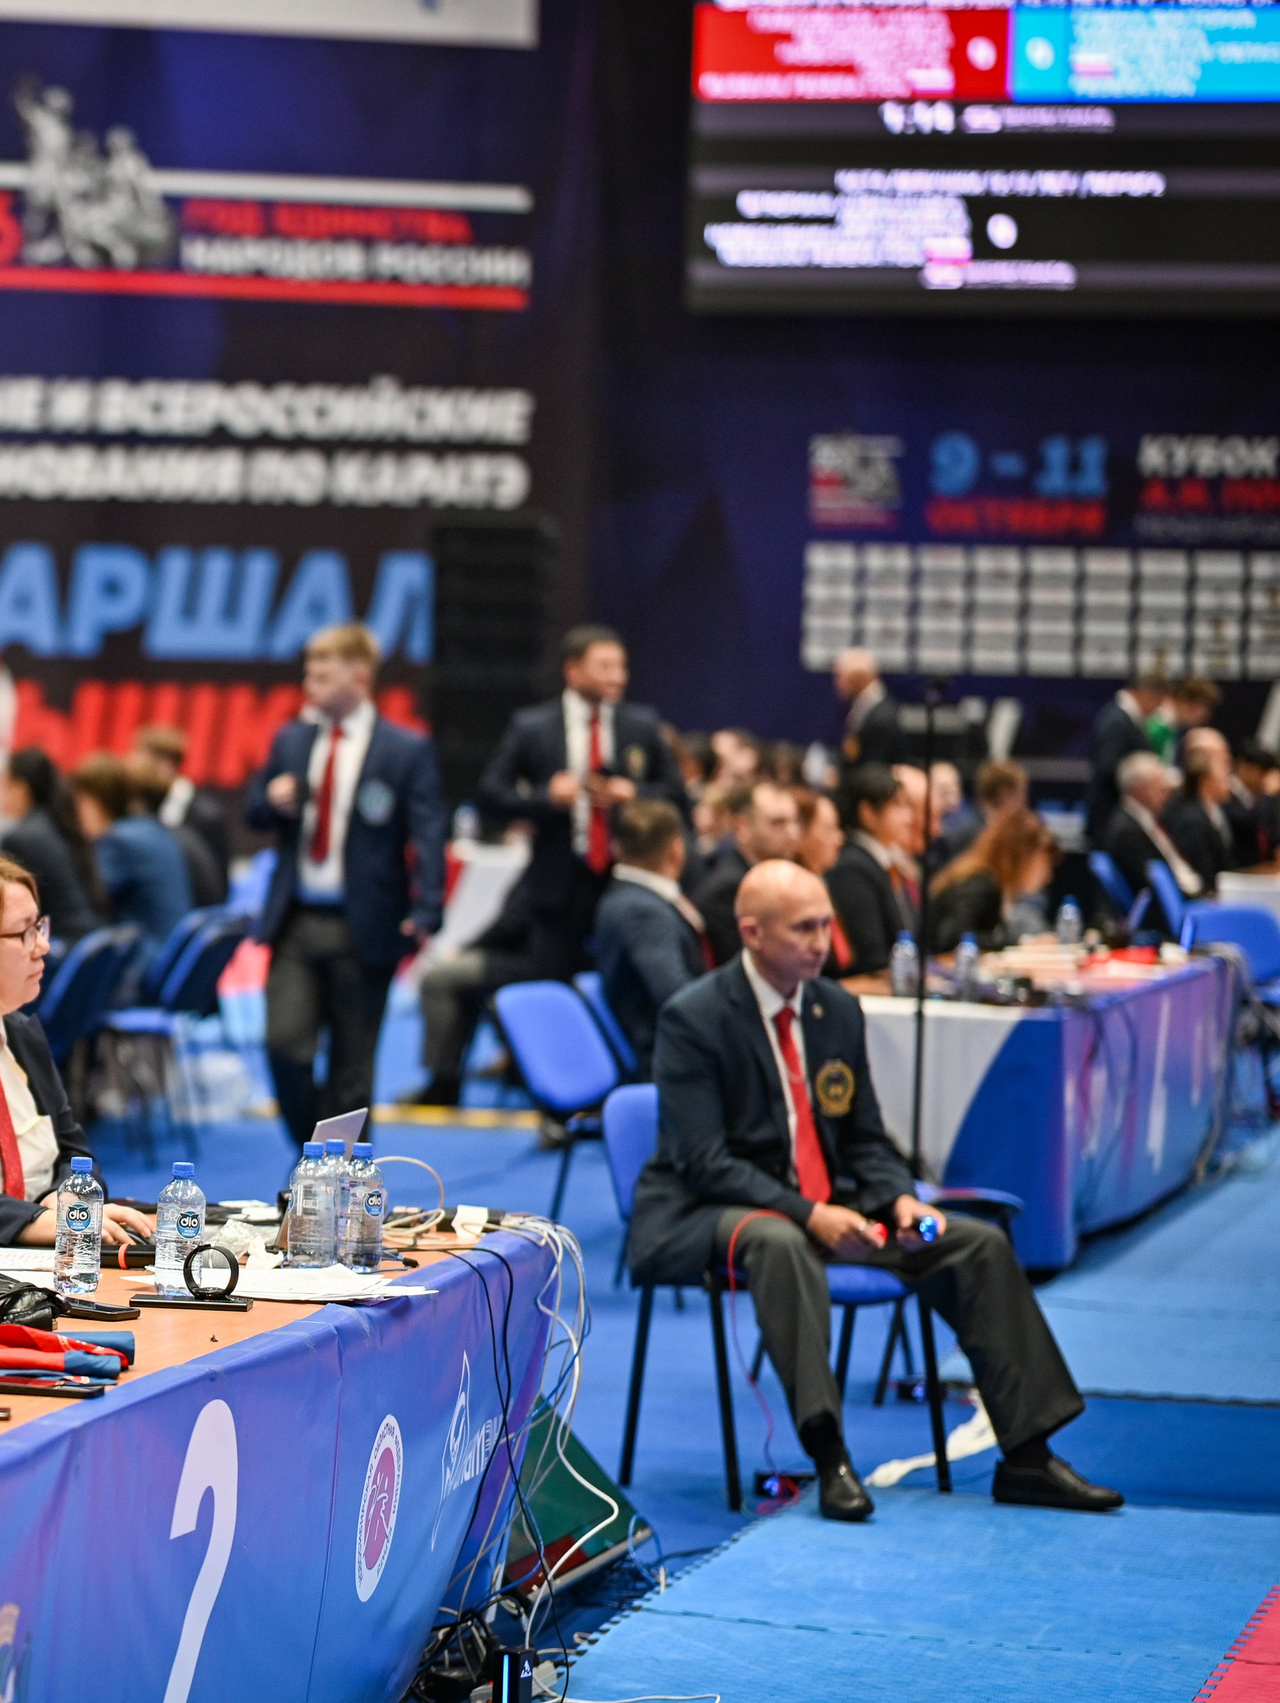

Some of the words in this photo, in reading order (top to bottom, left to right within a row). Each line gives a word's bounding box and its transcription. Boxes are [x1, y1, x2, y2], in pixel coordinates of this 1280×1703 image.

[181, 237, 365, 280] НАРОДОВ
[376, 243, 531, 288] РОССИИ
[98, 373, 533, 445] ВСЕРОССИЙСКИЕ
[248, 447, 327, 506] ПО
[333, 450, 530, 509] КАРАТЭ
[931, 431, 978, 496] 9
[1034, 434, 1108, 497] 11
[69, 1209, 88, 1220] dio
[180, 1216, 198, 1227] dio
[163, 1399, 238, 1703] 2
